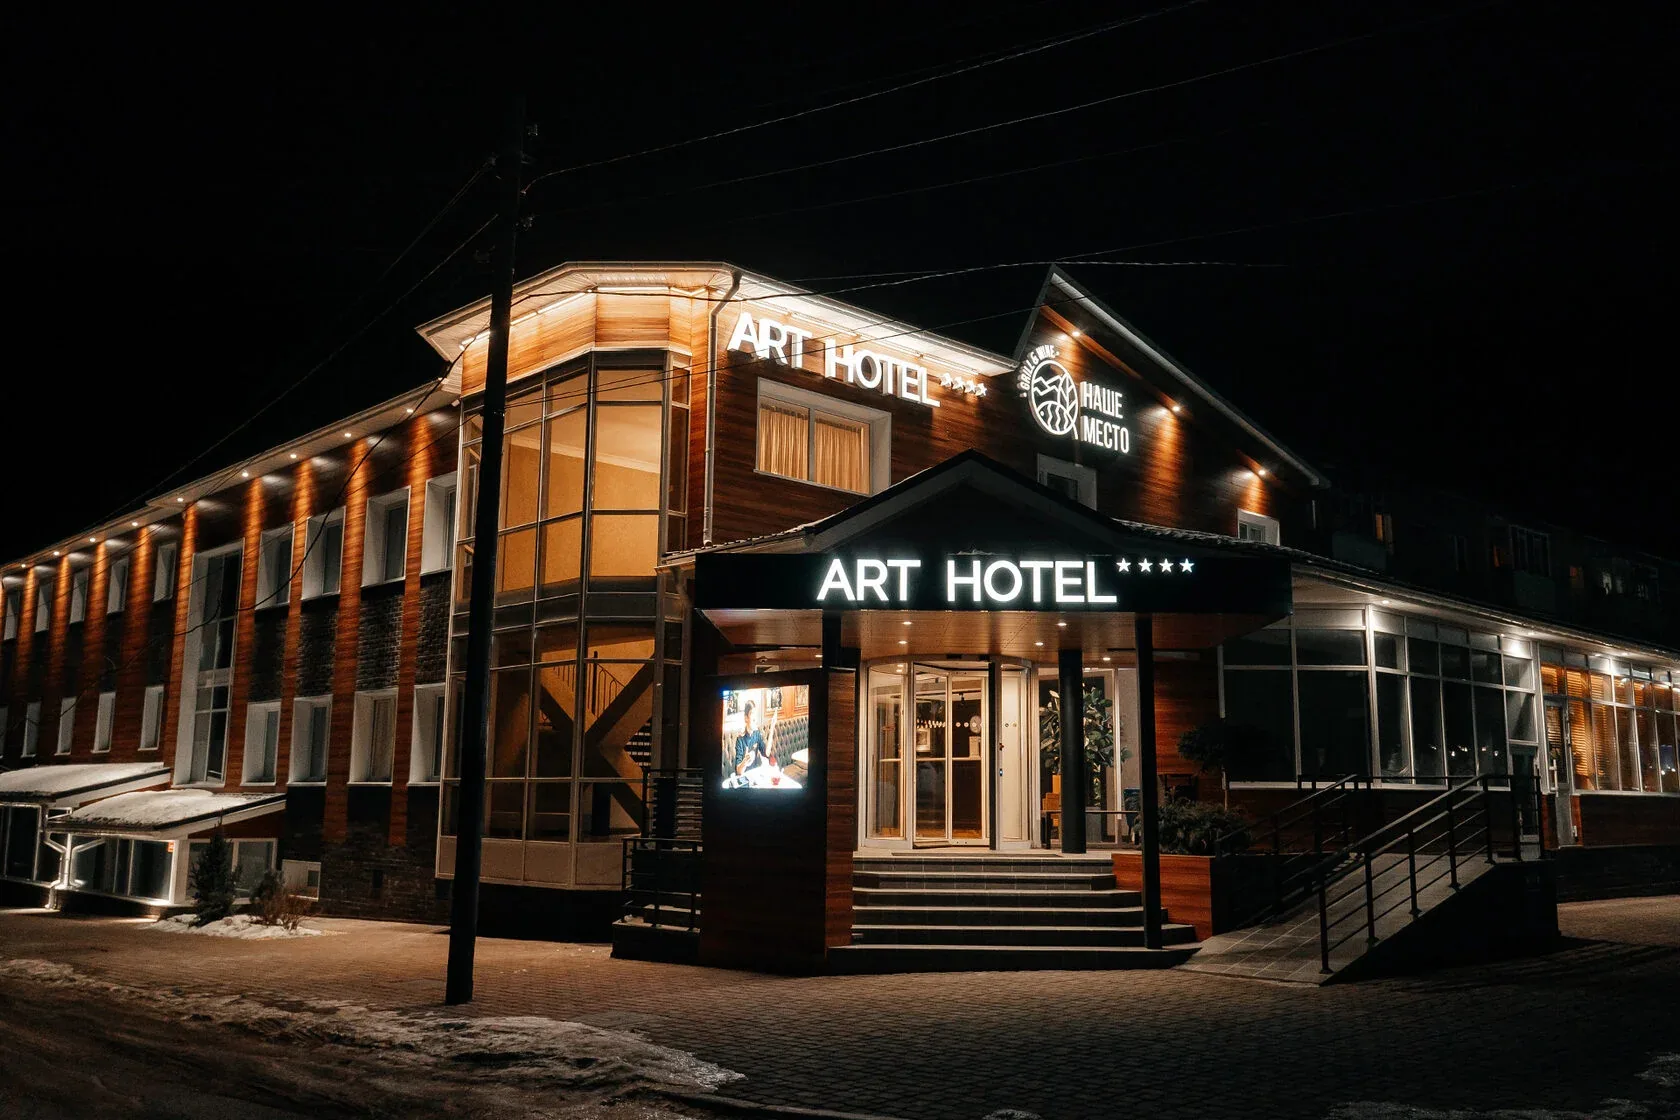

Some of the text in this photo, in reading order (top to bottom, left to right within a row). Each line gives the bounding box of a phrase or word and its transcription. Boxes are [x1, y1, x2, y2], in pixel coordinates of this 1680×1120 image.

[727, 312, 941, 408] ART HOTEL
[1019, 360, 1035, 391] GRILL
[1081, 381, 1124, 419] НАШЕ
[1082, 416, 1130, 454] МЕСТО
[817, 558, 1117, 604] ART HOTEL
